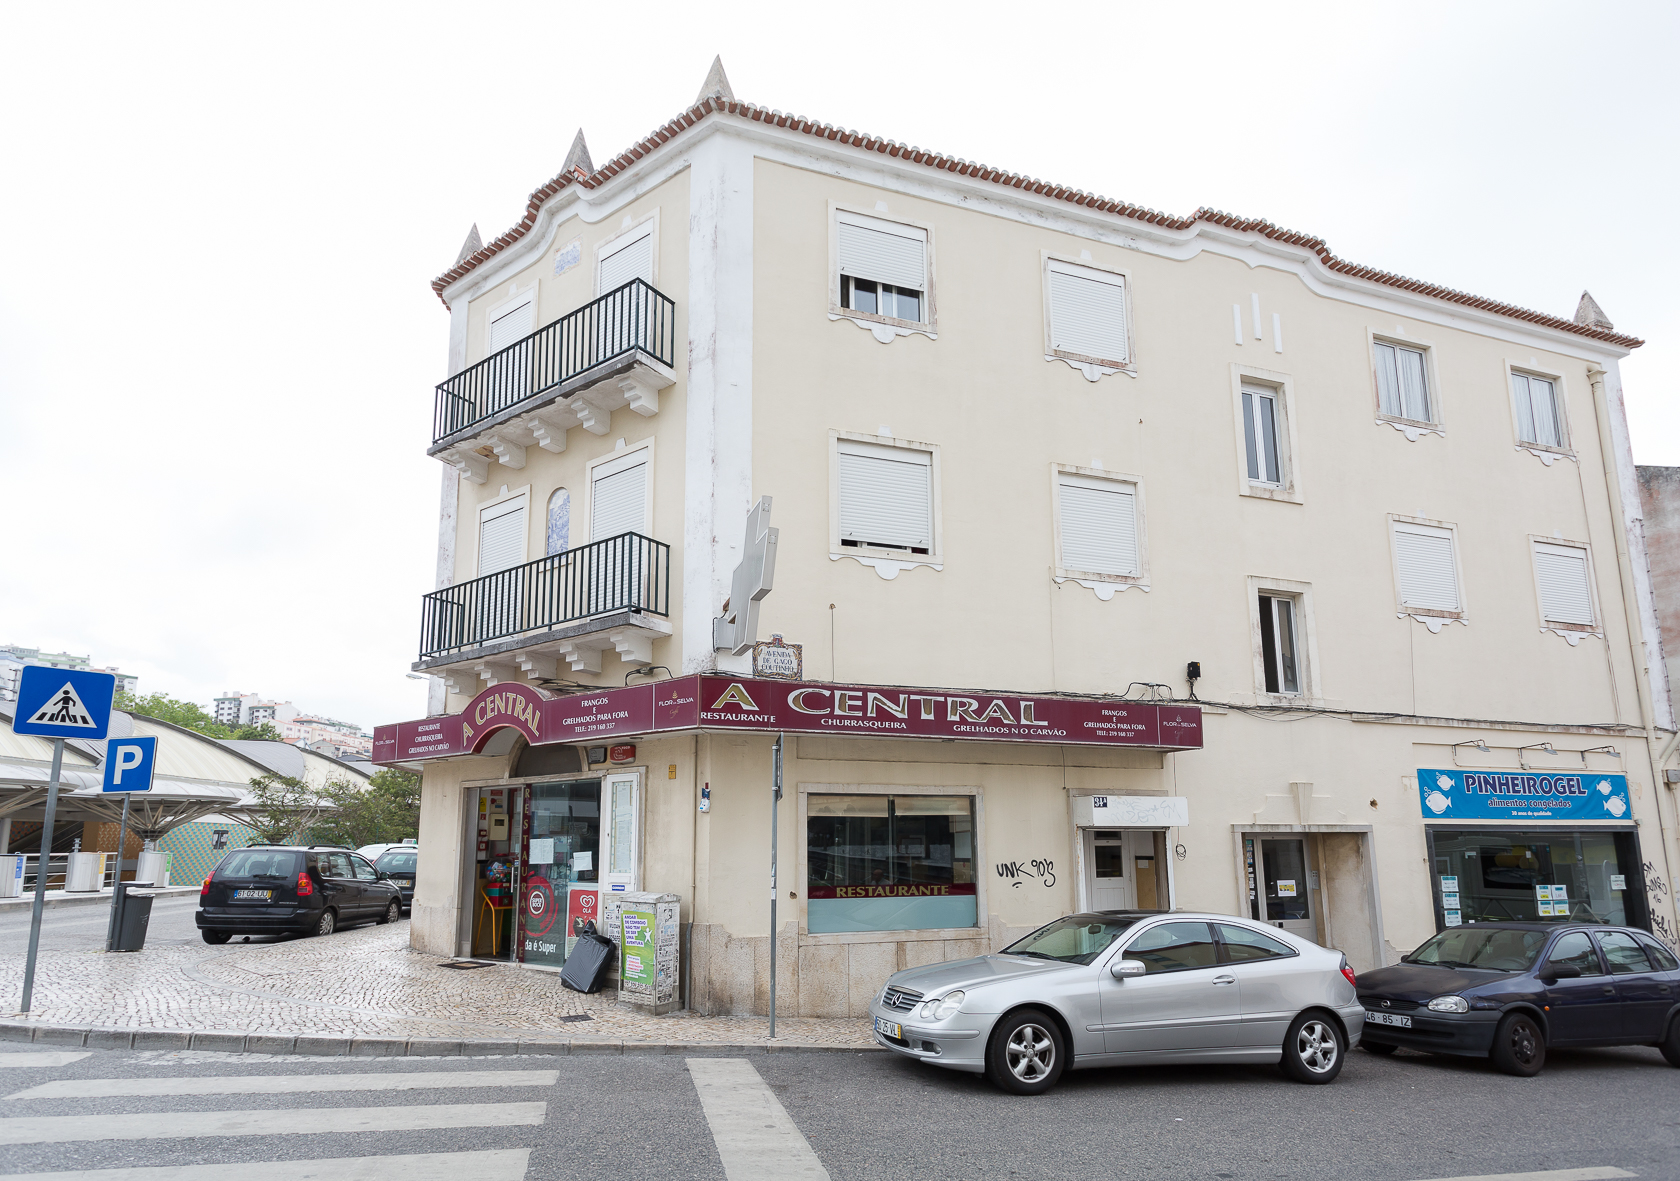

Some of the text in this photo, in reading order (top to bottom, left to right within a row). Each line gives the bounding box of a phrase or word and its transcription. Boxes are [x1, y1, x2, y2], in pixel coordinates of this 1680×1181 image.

[766, 650, 791, 659] AVENIDA
[774, 658, 793, 666] GAGO
[761, 664, 795, 673] COUTINHO
[581, 697, 609, 708] FRANGOS
[658, 699, 673, 707] FLOR
[676, 697, 694, 705] SELVA
[711, 683, 1049, 727] A CENTRAL
[592, 706, 597, 714] E
[1101, 709, 1128, 717] FRANGOS
[463, 692, 541, 747] A CENTRAL
[562, 710, 629, 726] GRELHADOS PARA FORA
[700, 711, 776, 723] RESTAURANTE
[417, 722, 441, 733] RESTAURANTE
[821, 718, 907, 730] CHURRASQUEIRA
[1083, 721, 1117, 730] GRELHADOS
[1131, 723, 1146, 731] FORA
[953, 724, 1009, 735] GRELHADOS
[1030, 727, 1067, 737] CARVÃO
[414, 733, 444, 743] CHURRASQUEIRA
[408, 745, 429, 755] GRELHADOS
[434, 741, 450, 752] CARVÃO
[113, 745, 143, 785] P
[1463, 774, 1588, 796] PINHEIROGEL
[1488, 797, 1572, 810] alimentos congelados
[996, 861, 1035, 878] UNK
[836, 885, 950, 898] RESTAURANTE
[538, 941, 557, 956] Super
